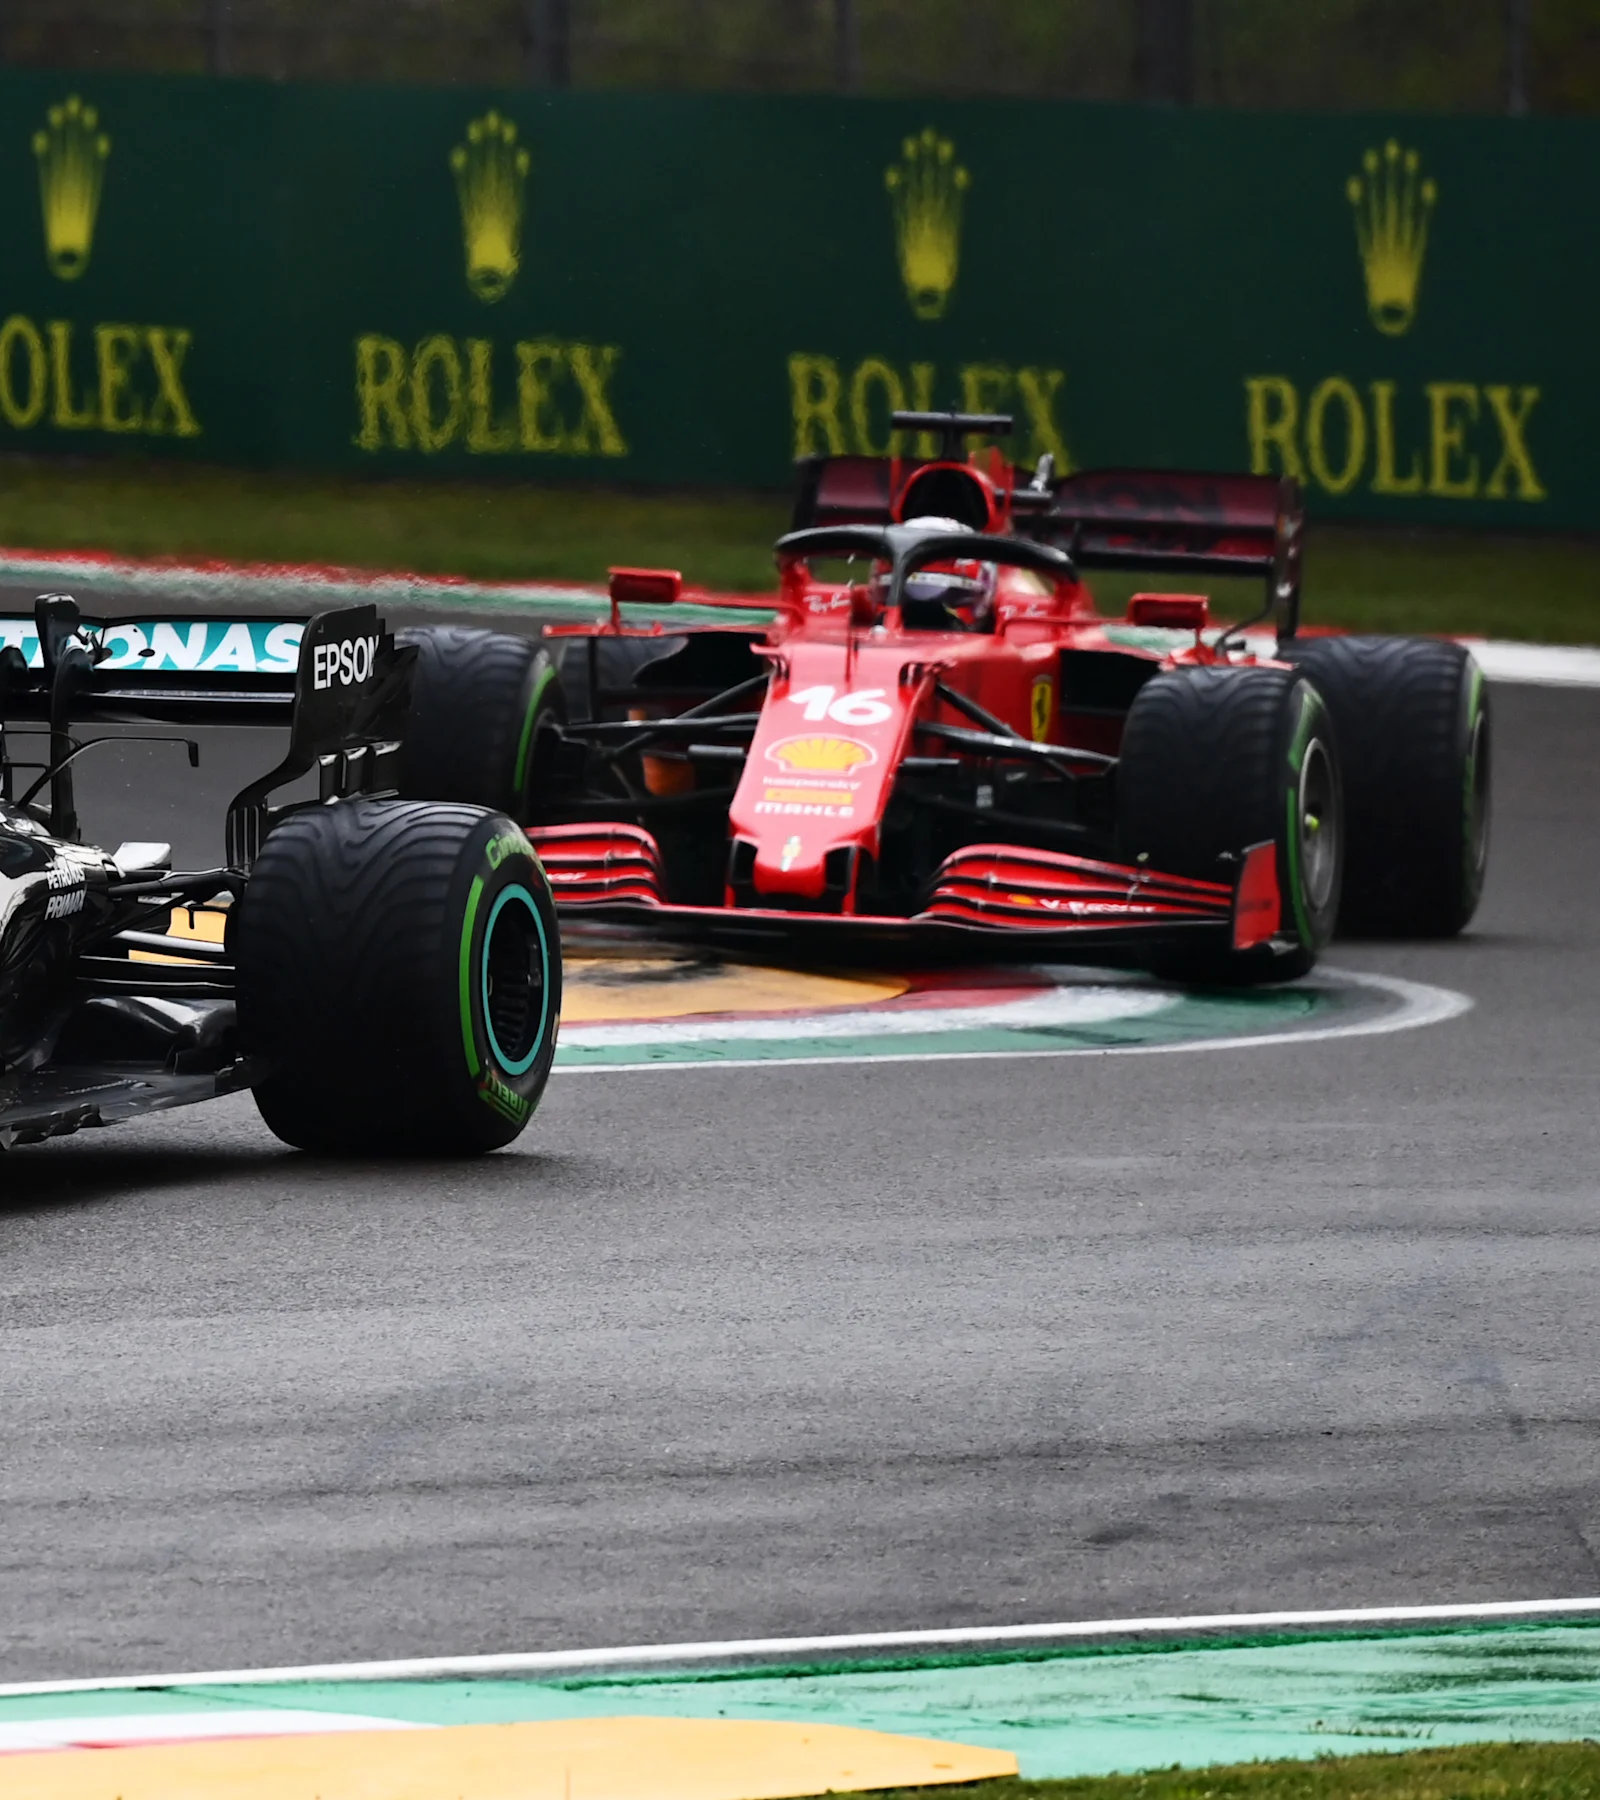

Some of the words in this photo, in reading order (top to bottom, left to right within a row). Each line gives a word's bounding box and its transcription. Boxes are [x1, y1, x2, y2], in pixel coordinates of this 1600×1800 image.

[352, 333, 630, 457] ROLEX
[1246, 375, 1546, 503] ROLEX
[313, 634, 380, 691] EPSON
[787, 685, 893, 726] 16
